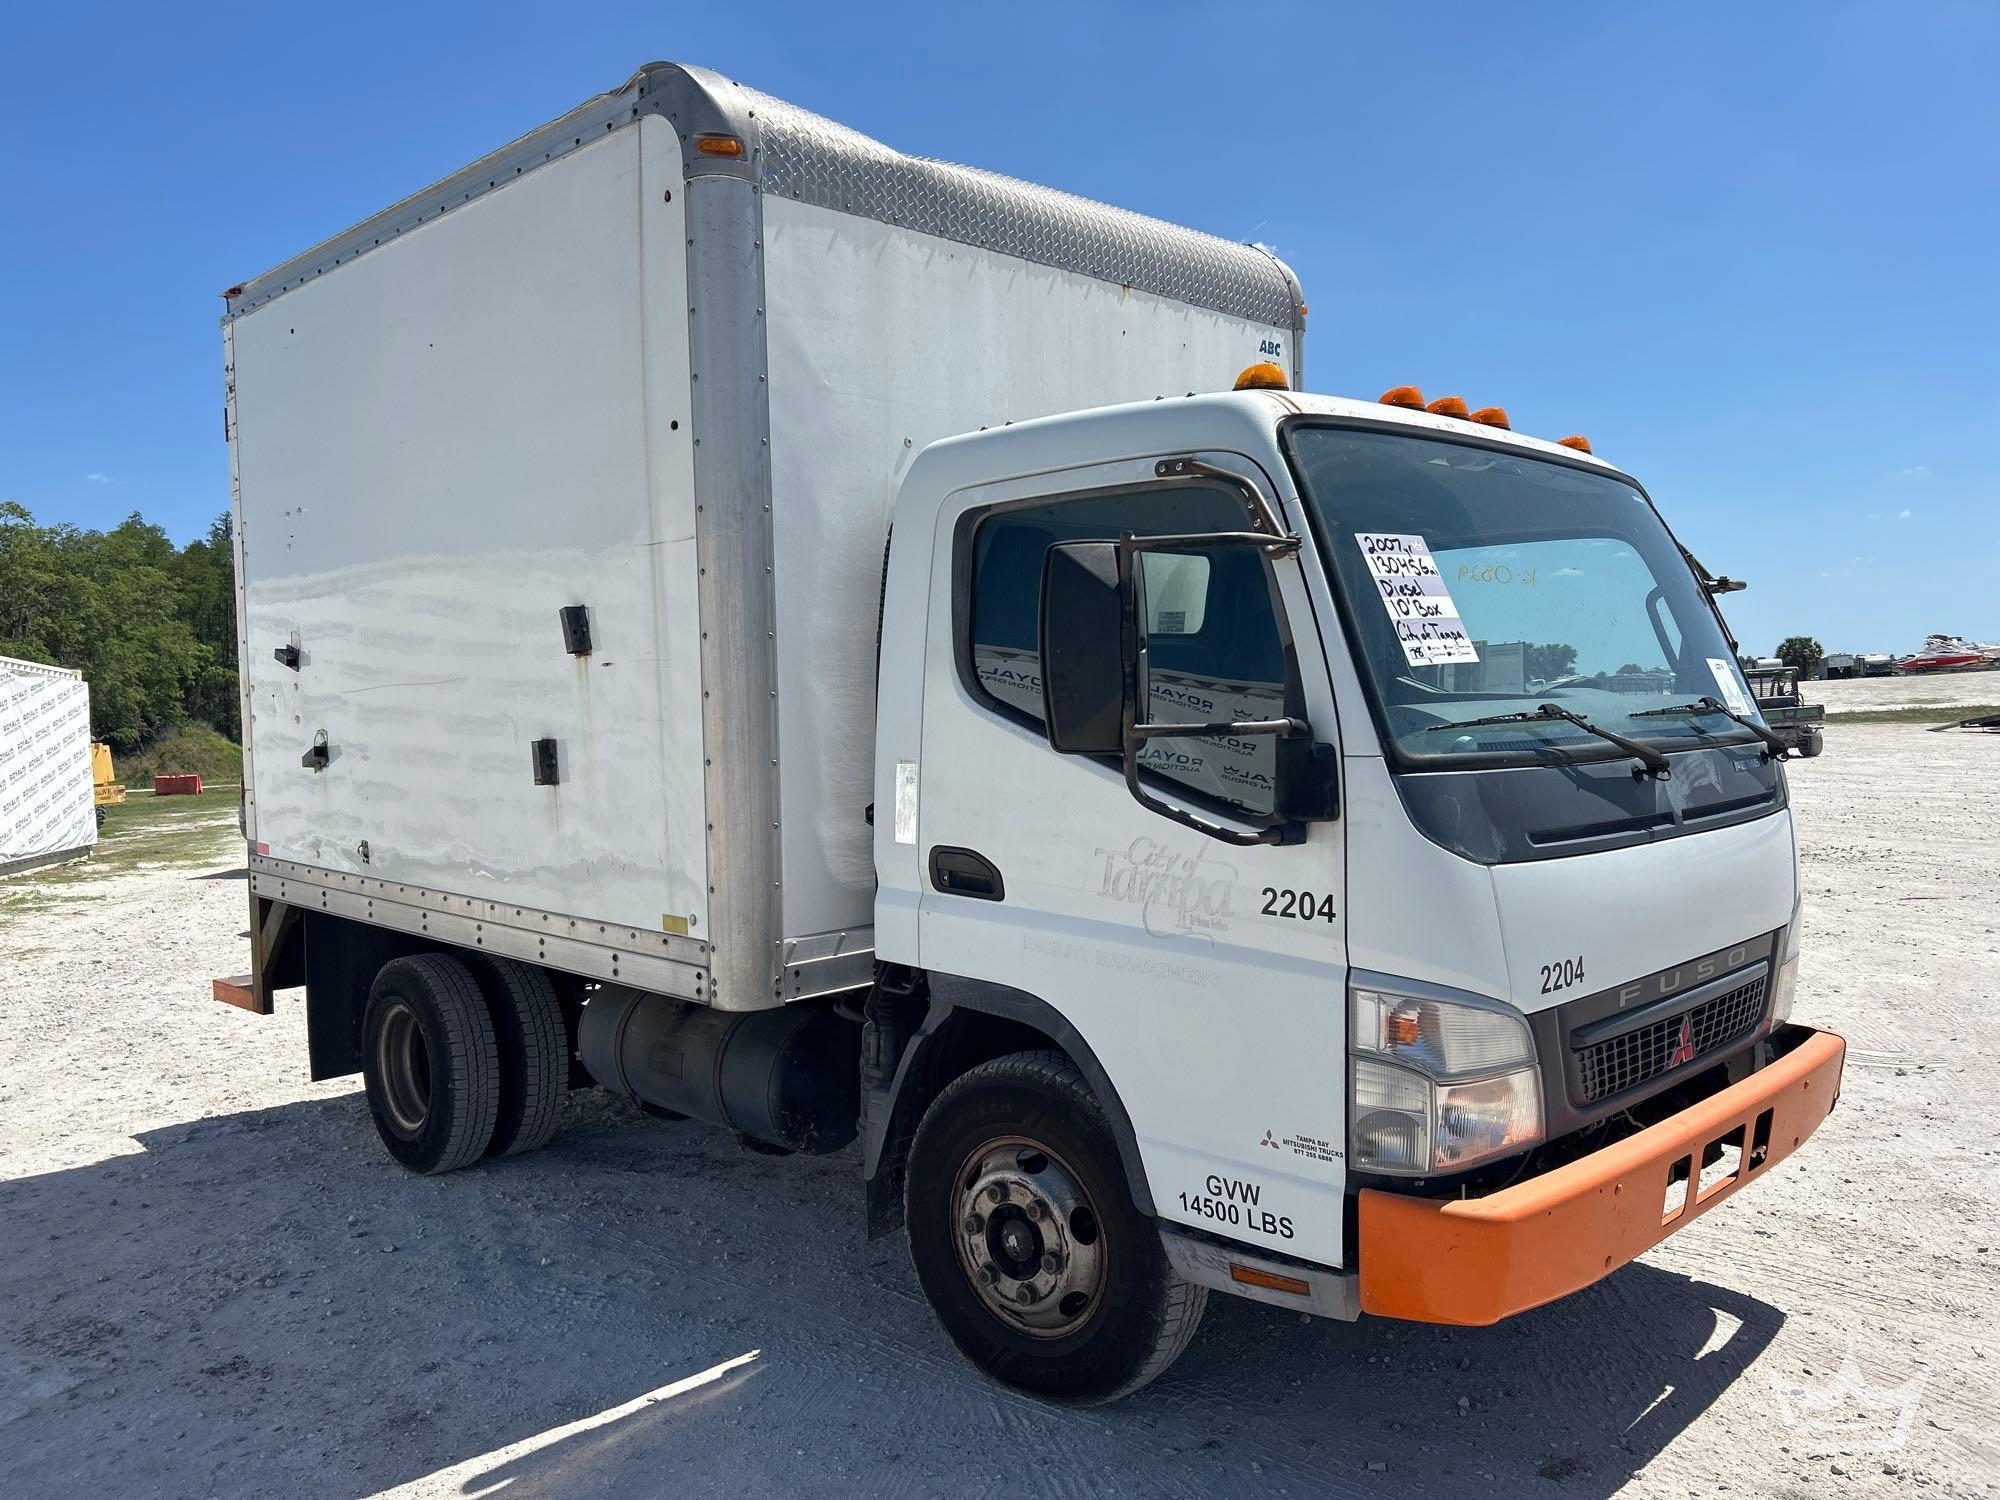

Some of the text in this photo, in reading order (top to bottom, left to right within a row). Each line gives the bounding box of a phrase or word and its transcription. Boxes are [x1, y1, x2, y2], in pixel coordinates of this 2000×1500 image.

[1259, 339, 1281, 357] ABC
[1364, 536, 1402, 554] 2007
[1380, 579, 1426, 597] Diesel
[1412, 600, 1443, 618] Box
[1396, 620, 1423, 645] City
[1428, 622, 1465, 646] Tampa
[1260, 887, 1337, 924] 2204
[1539, 955, 1585, 995] 2204
[1618, 947, 1746, 1009] FUSO
[1282, 1138, 1344, 1159] MITSUBISHI TRUCKS
[1295, 1134, 1330, 1148] TAMPA BAY
[1206, 1174, 1261, 1206] GVW
[1178, 1191, 1295, 1239] 14500 LBS
